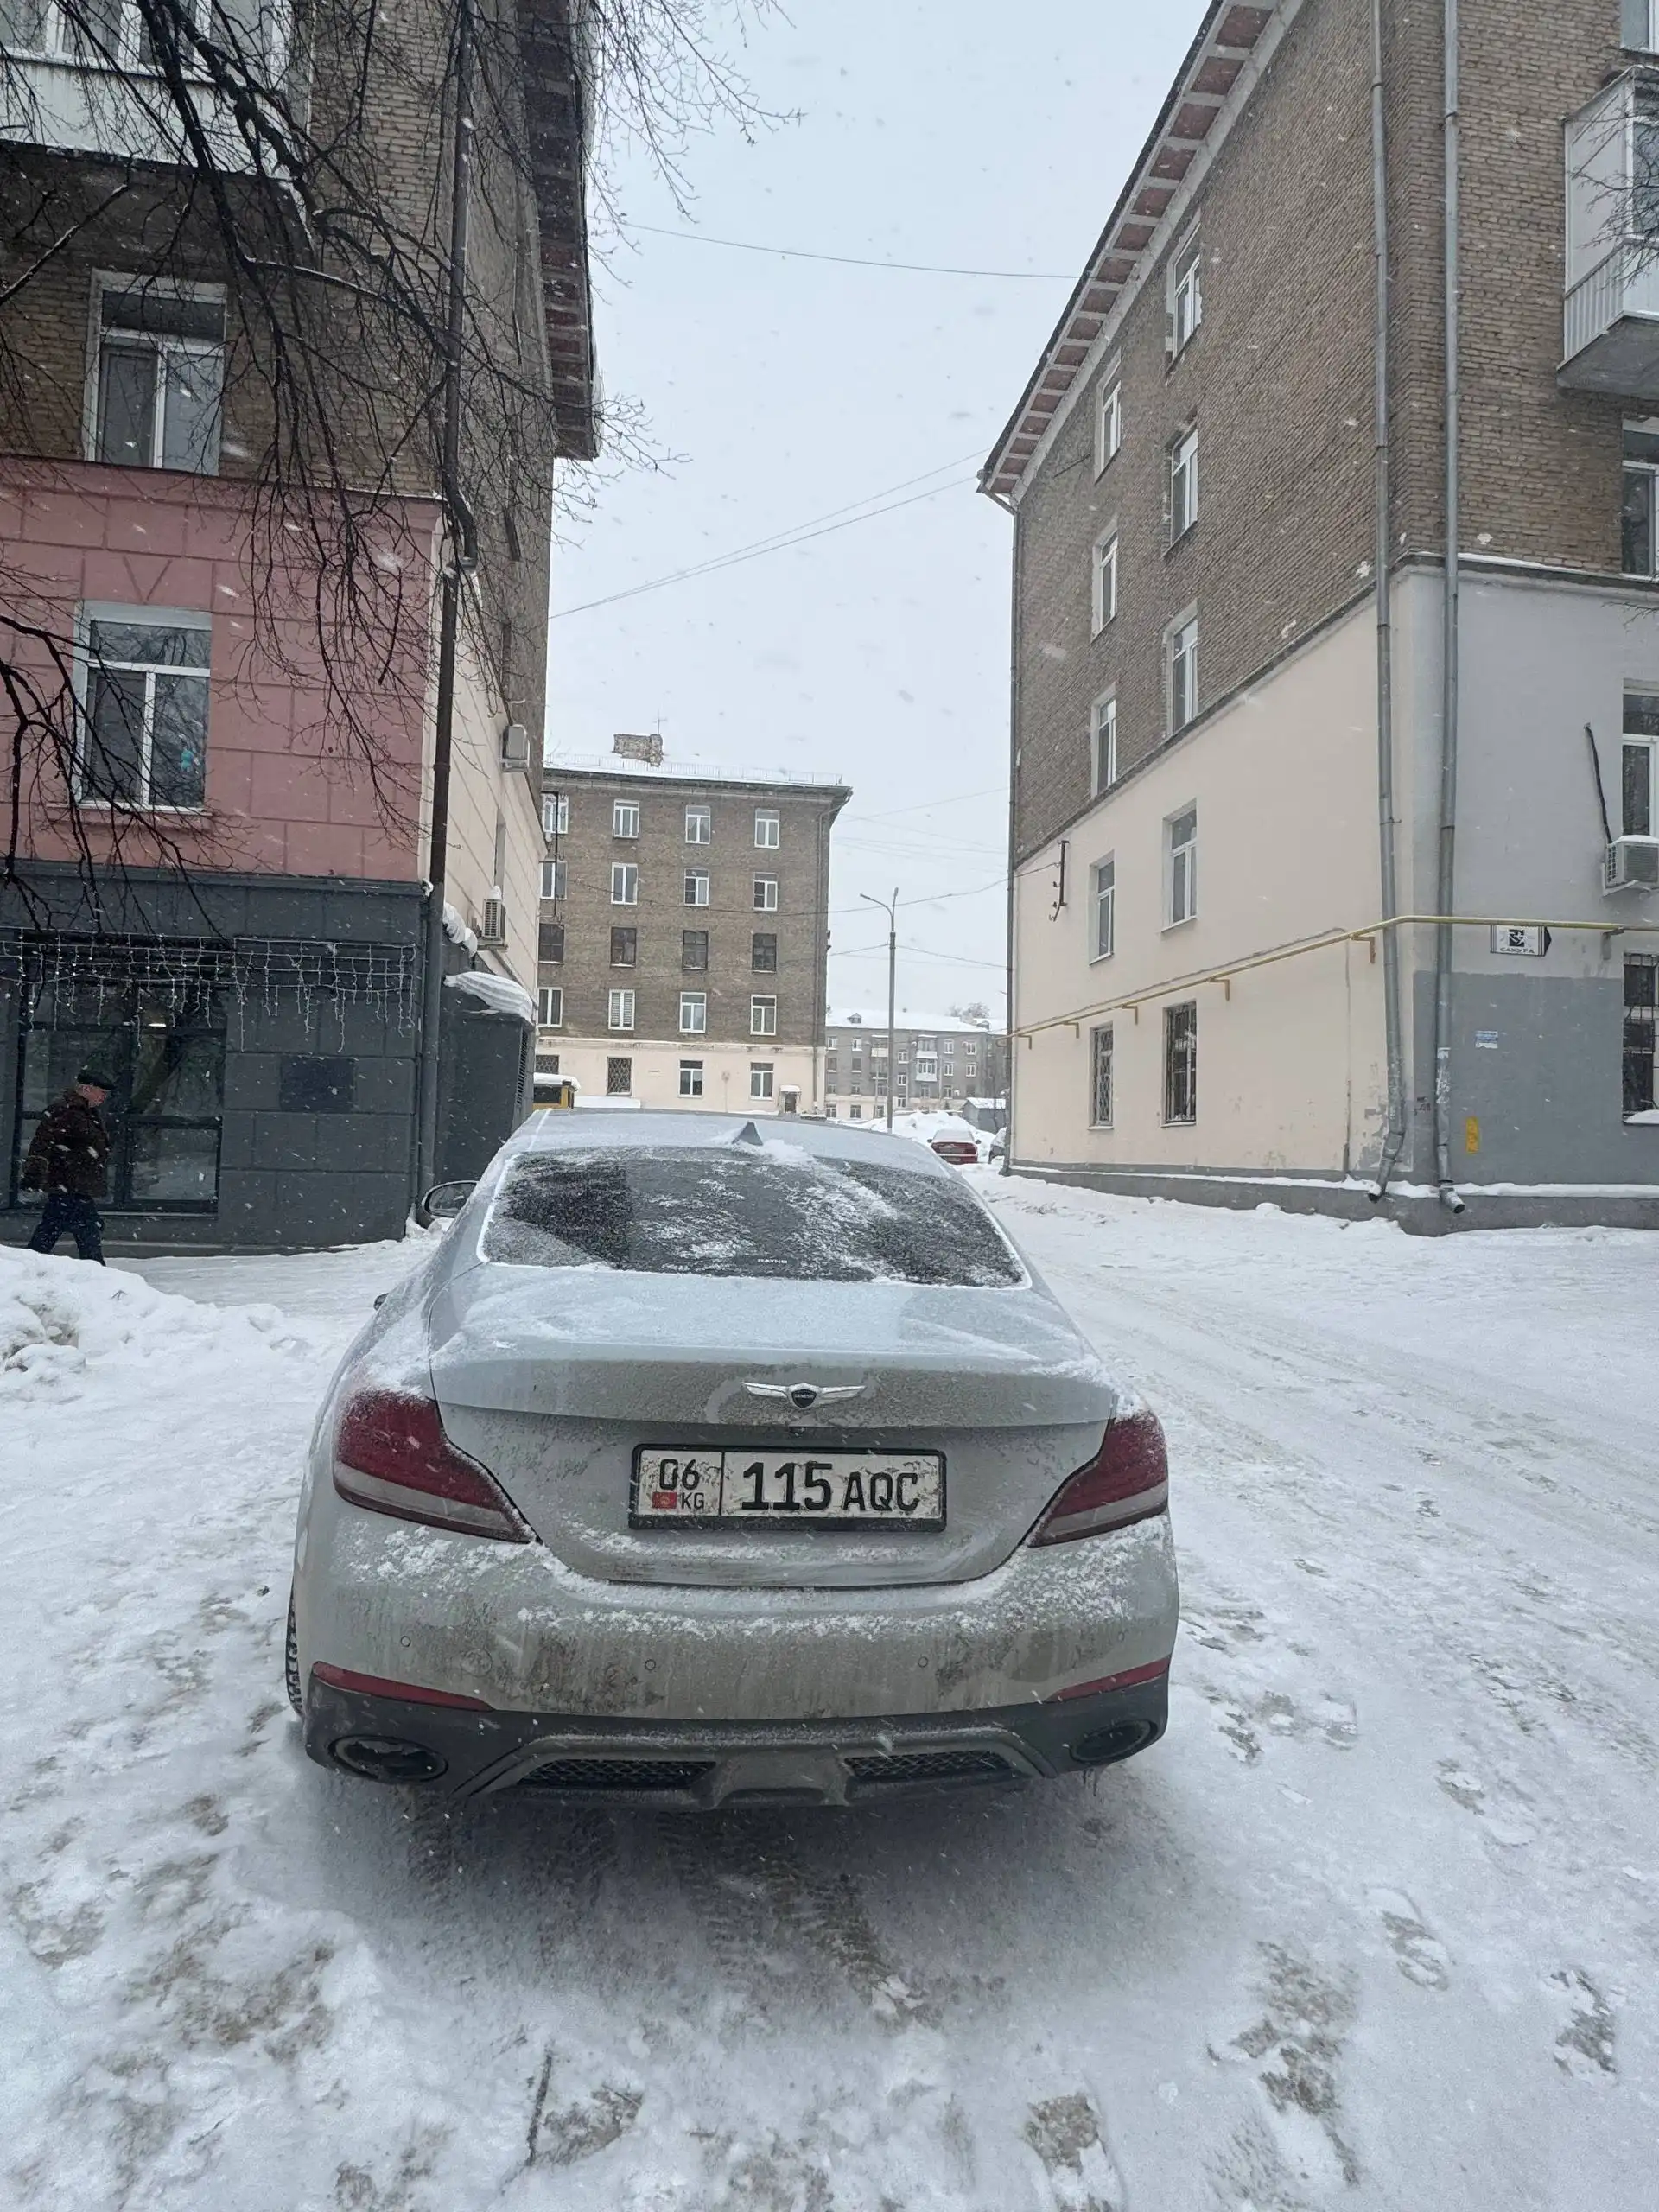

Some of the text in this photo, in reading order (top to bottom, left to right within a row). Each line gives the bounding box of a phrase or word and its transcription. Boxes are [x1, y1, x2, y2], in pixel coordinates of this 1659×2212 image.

[660, 1459, 700, 1491] 06
[742, 1462, 833, 1510] 115
[681, 1492, 704, 1510] KG
